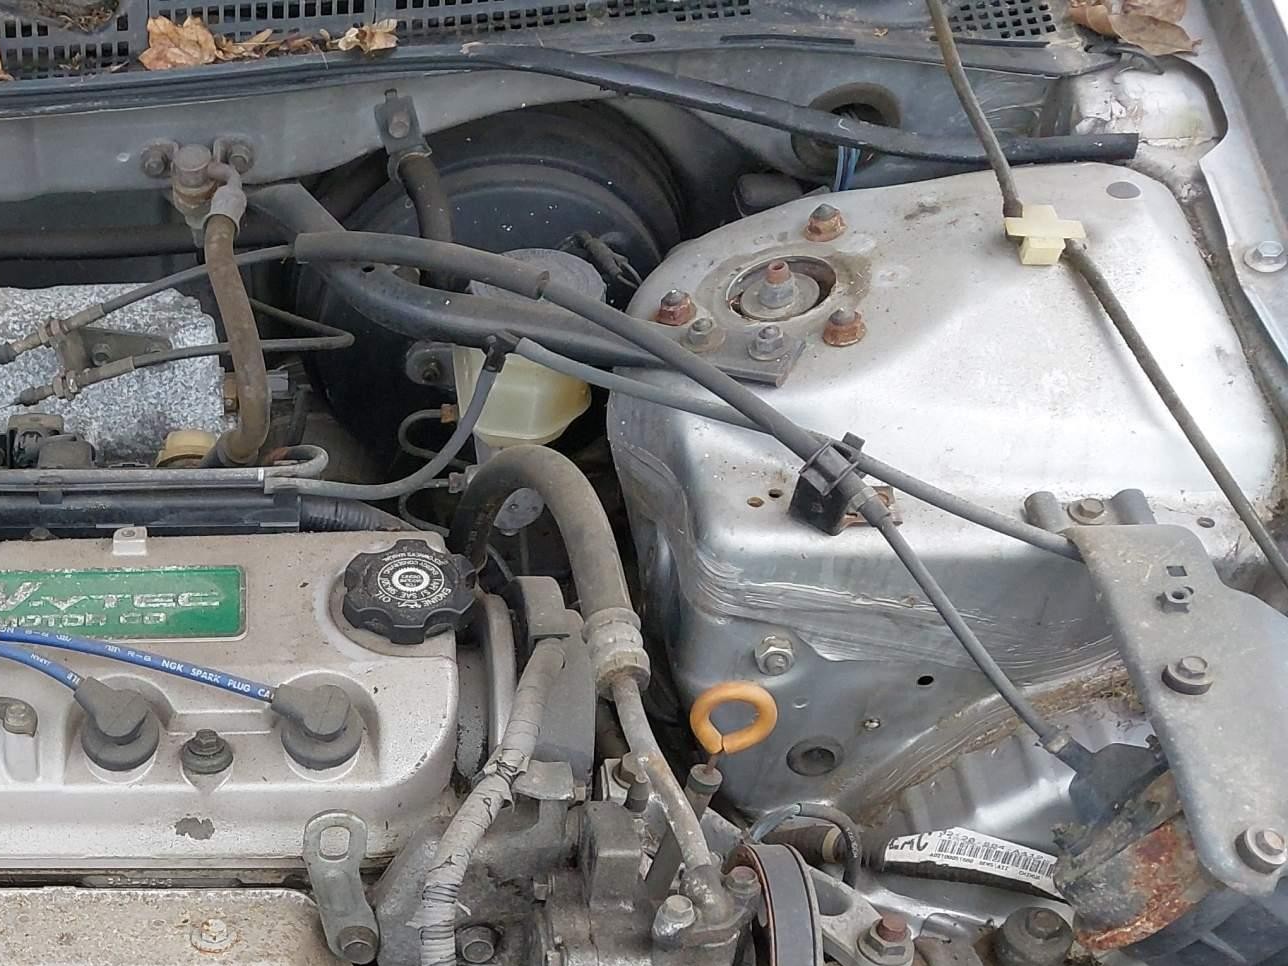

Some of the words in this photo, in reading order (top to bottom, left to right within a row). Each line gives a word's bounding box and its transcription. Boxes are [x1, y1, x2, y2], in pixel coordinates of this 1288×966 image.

[375, 590, 392, 603] OIL
[422, 587, 452, 606] ENGINE
[161, 659, 185, 673] NGK
[190, 667, 222, 684] SPARK
[227, 678, 251, 693] PLUG
